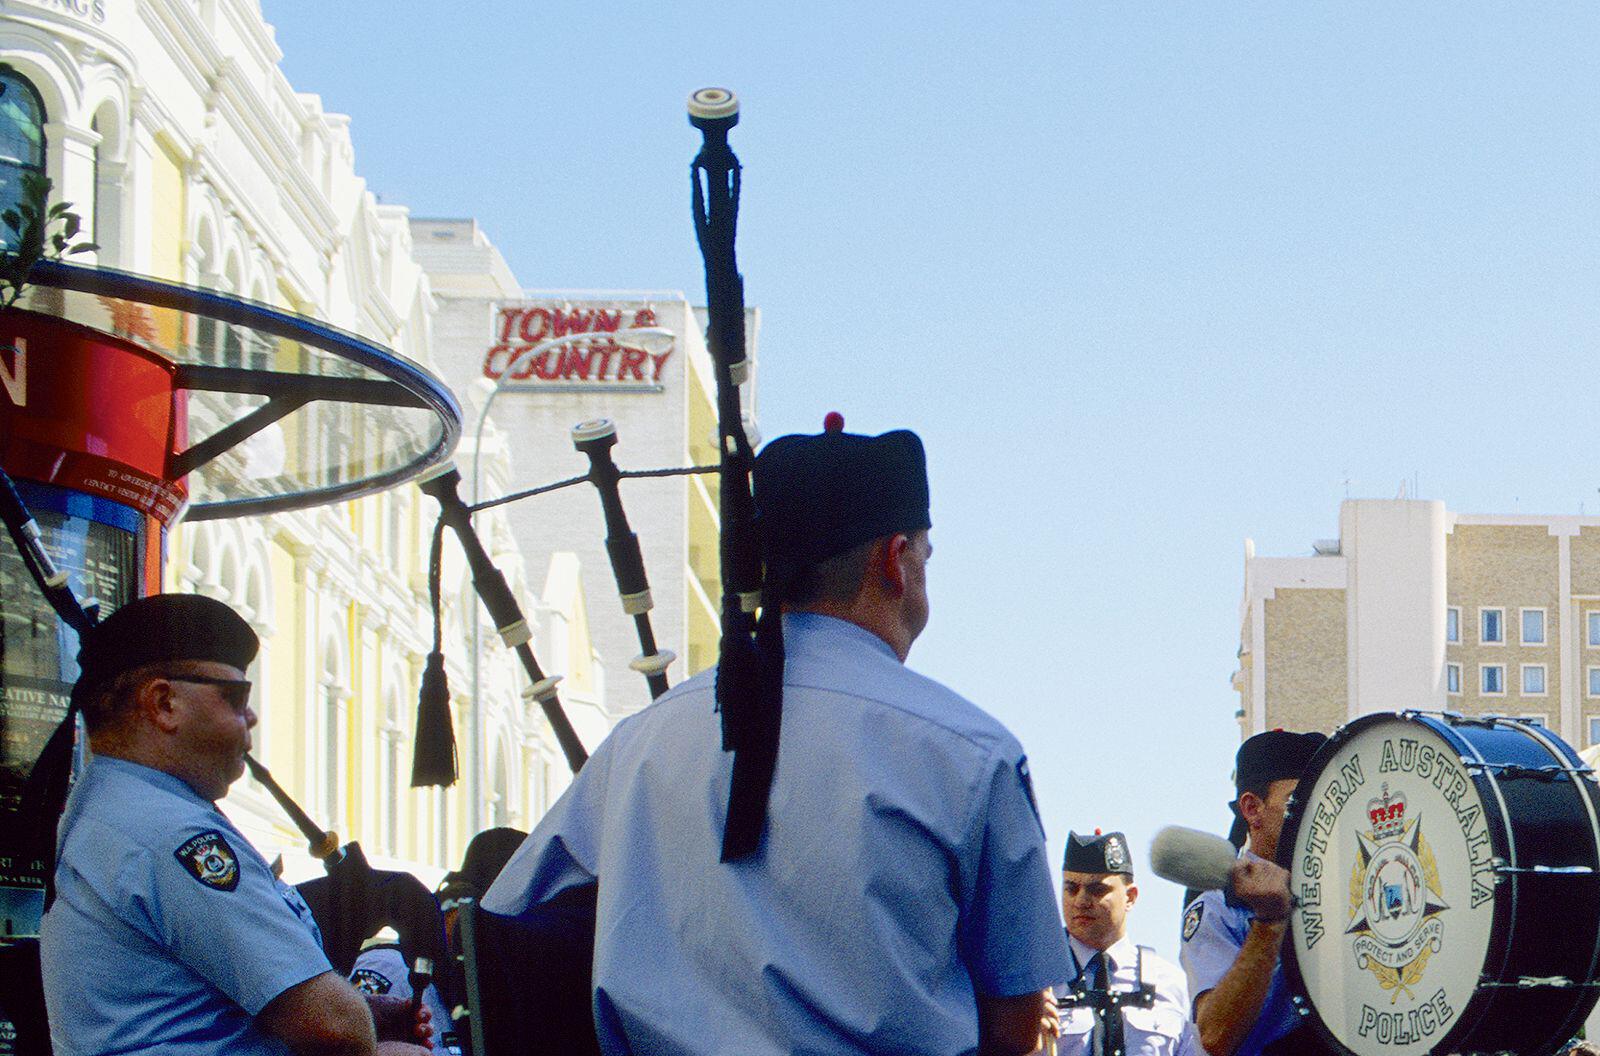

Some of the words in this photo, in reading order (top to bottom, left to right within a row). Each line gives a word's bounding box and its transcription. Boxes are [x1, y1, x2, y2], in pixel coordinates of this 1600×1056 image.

[501, 308, 622, 344] TOWN
[483, 345, 671, 382] COUNTRY
[1301, 753, 1366, 951] WESTERN
[1378, 737, 1496, 910] AUSTRALIA
[1356, 939, 1393, 963] PROTECT
[1395, 947, 1414, 963] AND
[1414, 923, 1440, 950] SERVE
[1358, 987, 1455, 1046] POLICE
